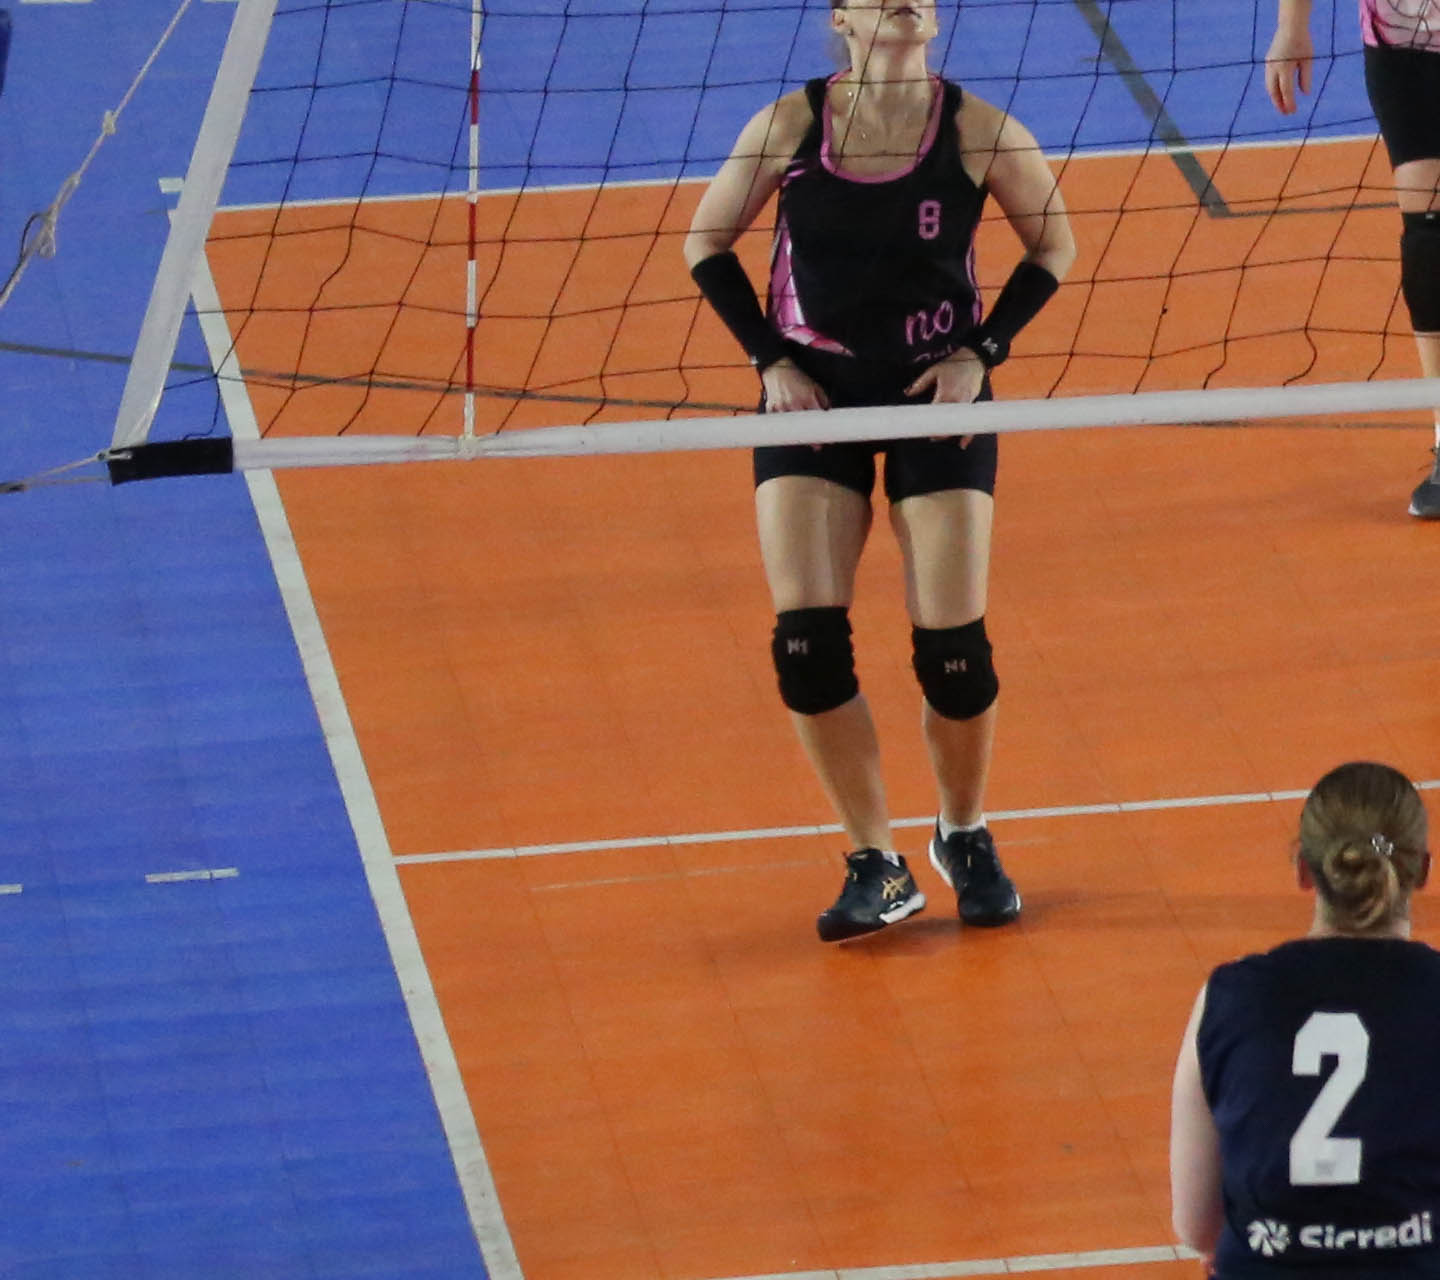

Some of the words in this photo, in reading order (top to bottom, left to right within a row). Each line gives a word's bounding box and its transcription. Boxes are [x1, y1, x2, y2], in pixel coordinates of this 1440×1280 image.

[917, 200, 941, 239] 8
[905, 300, 953, 345] no
[1290, 1012, 1370, 1187] 2
